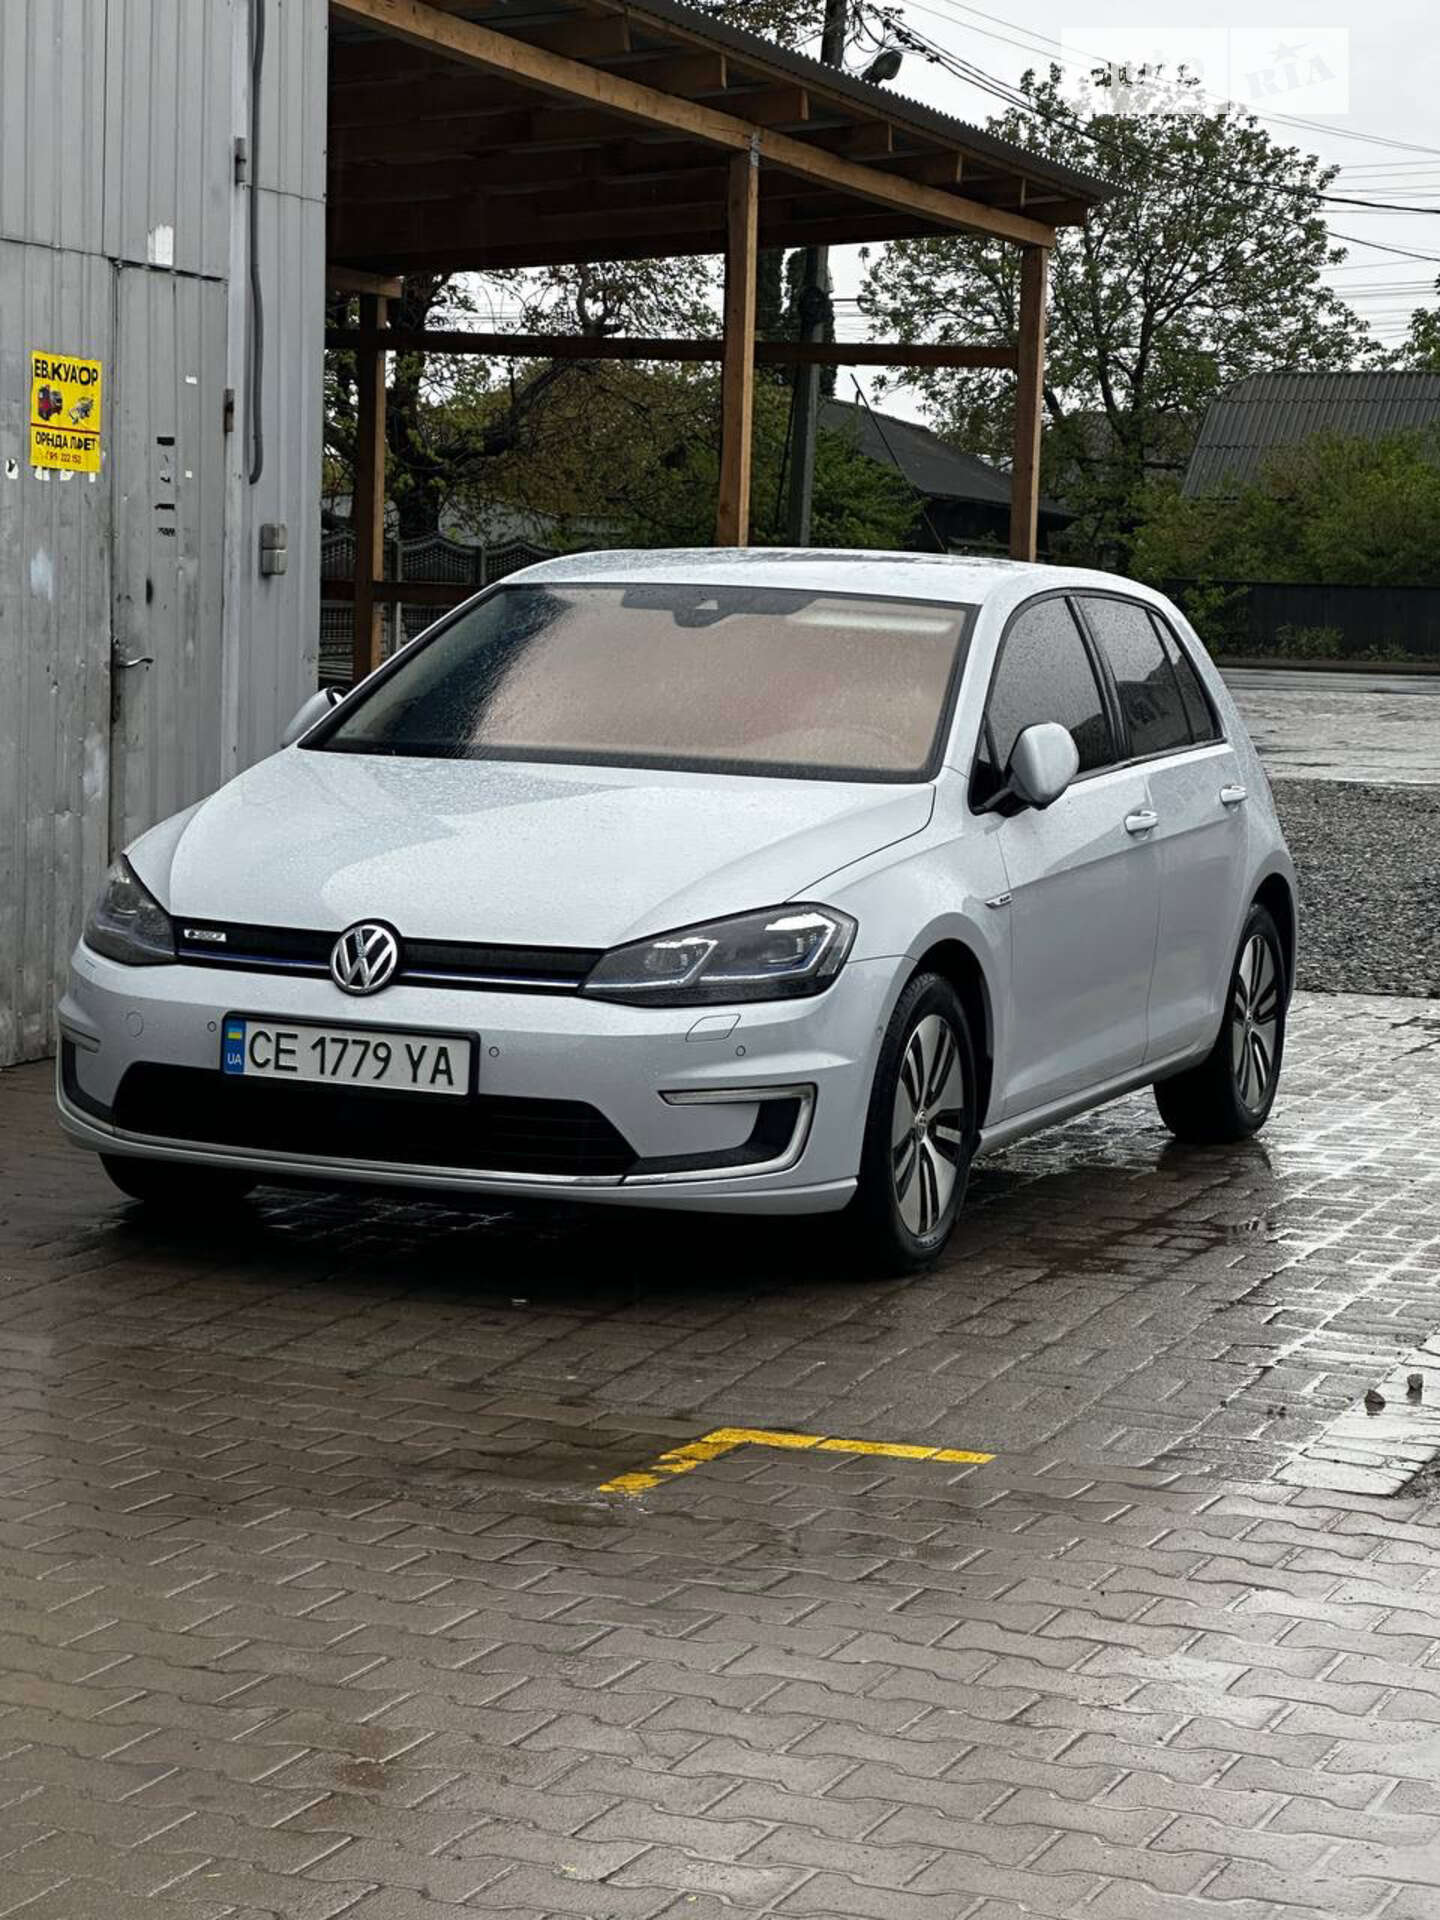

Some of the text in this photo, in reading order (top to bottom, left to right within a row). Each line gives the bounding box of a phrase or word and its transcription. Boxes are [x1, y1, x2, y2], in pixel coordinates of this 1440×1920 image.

[227, 1052, 242, 1066] UA
[249, 1030, 454, 1087] CE 1779 YA
